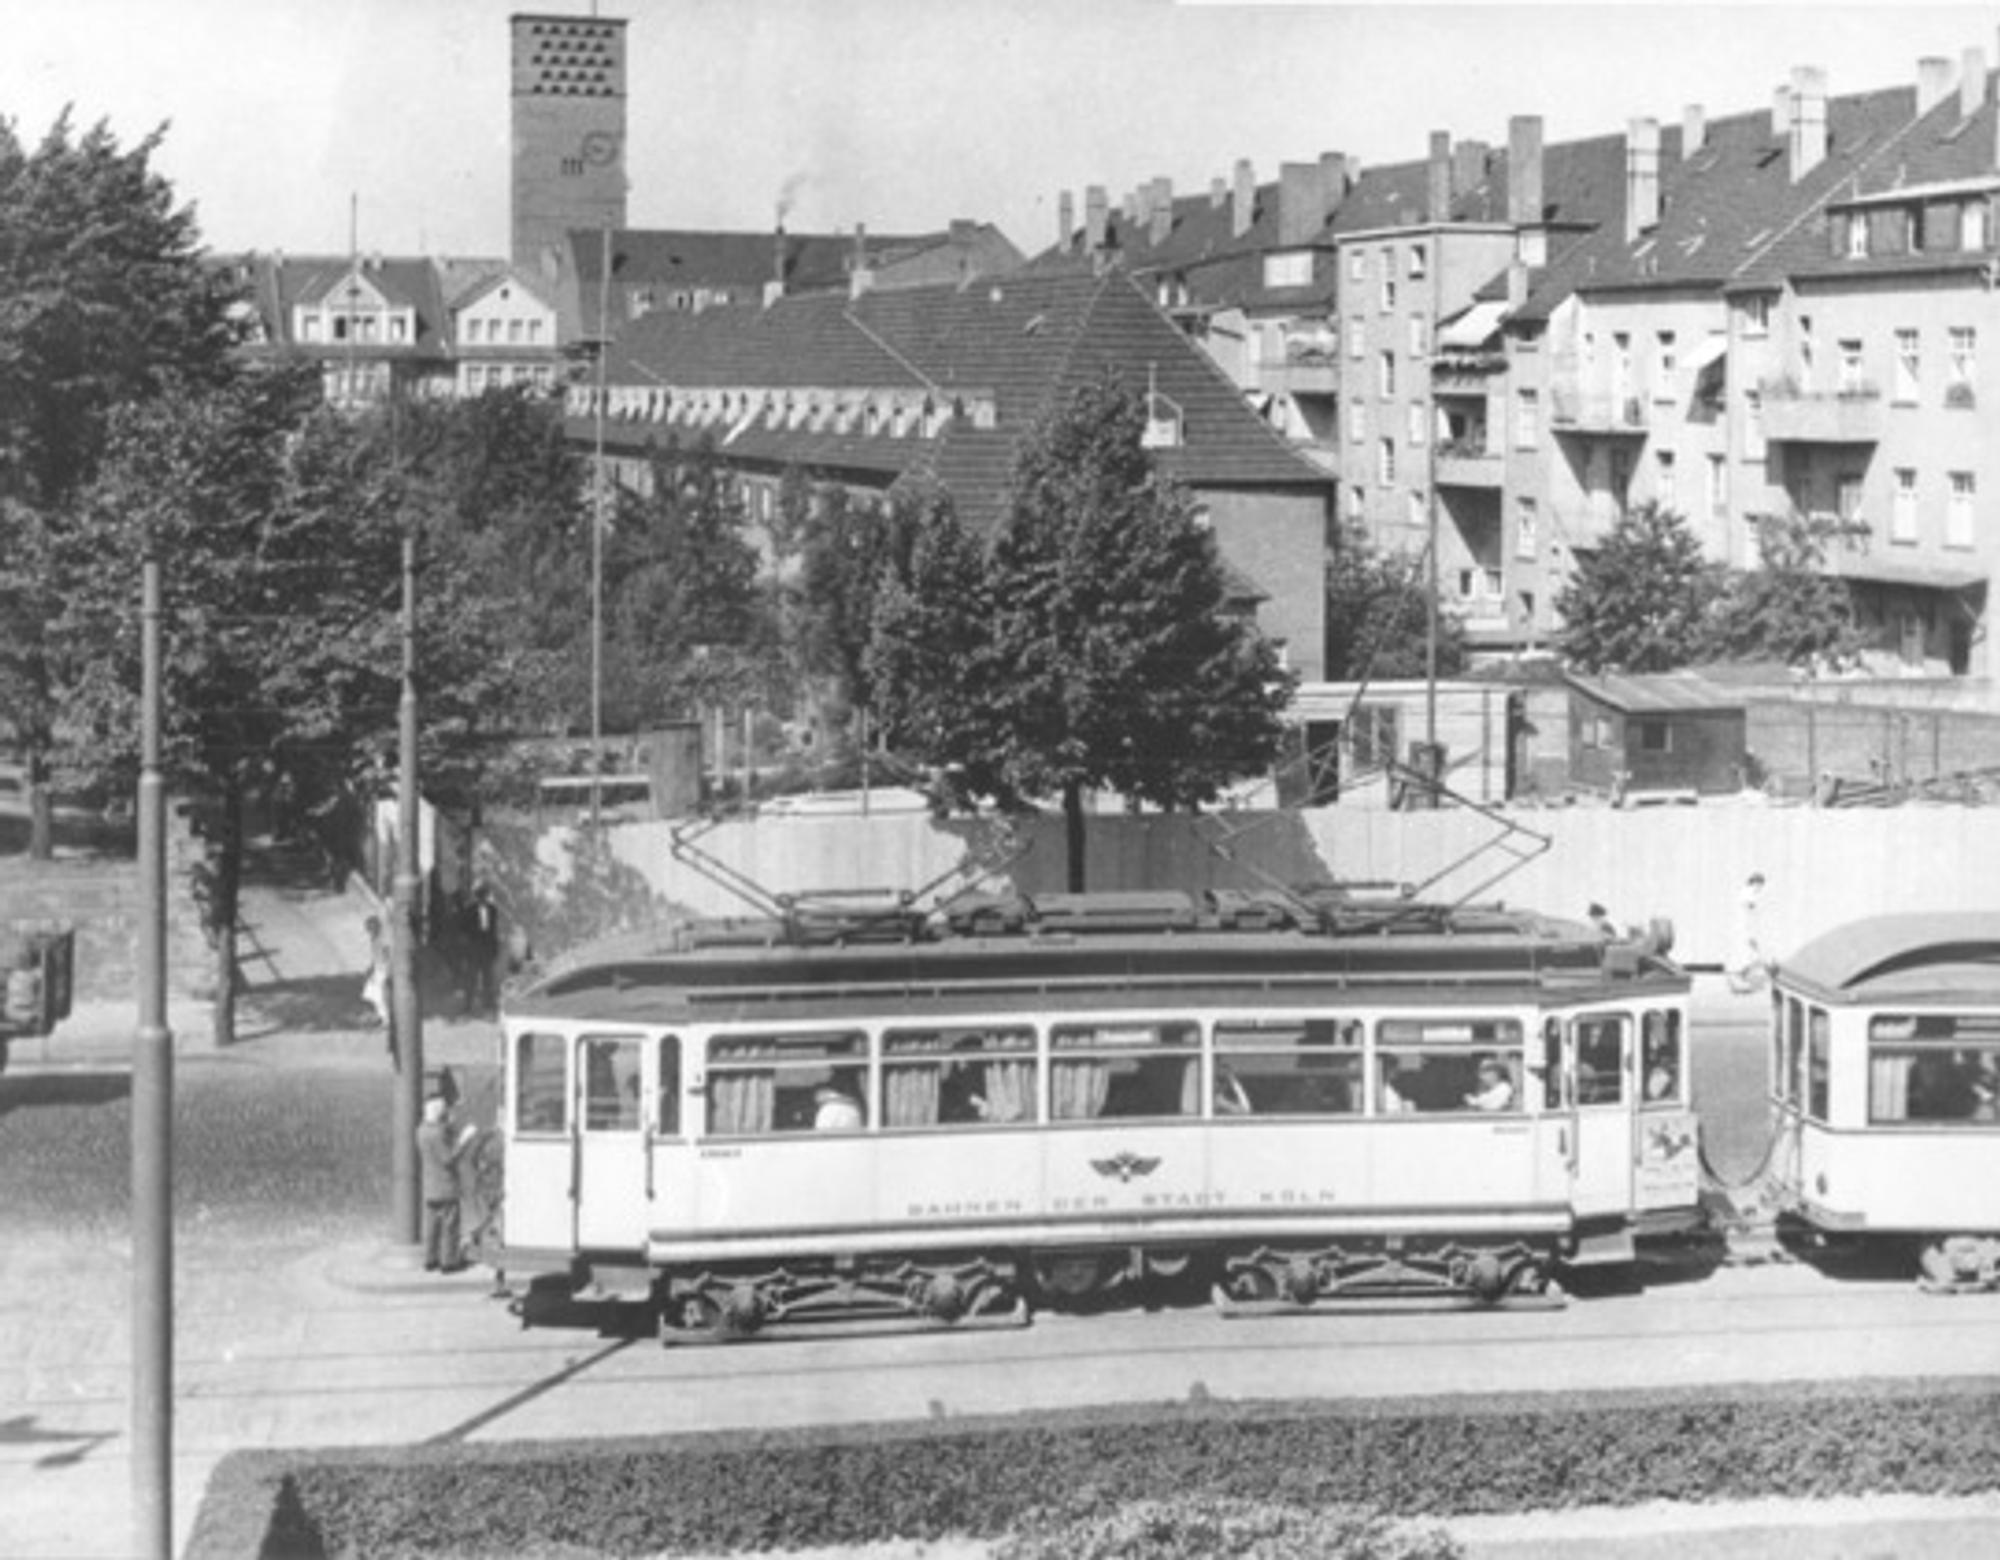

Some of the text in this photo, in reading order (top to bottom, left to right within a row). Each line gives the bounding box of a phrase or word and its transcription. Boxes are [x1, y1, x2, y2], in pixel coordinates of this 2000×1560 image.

[908, 1200, 1021, 1216] BAHNEN
[1053, 1196, 1108, 1210] DER
[1141, 1191, 1226, 1206] STADT
